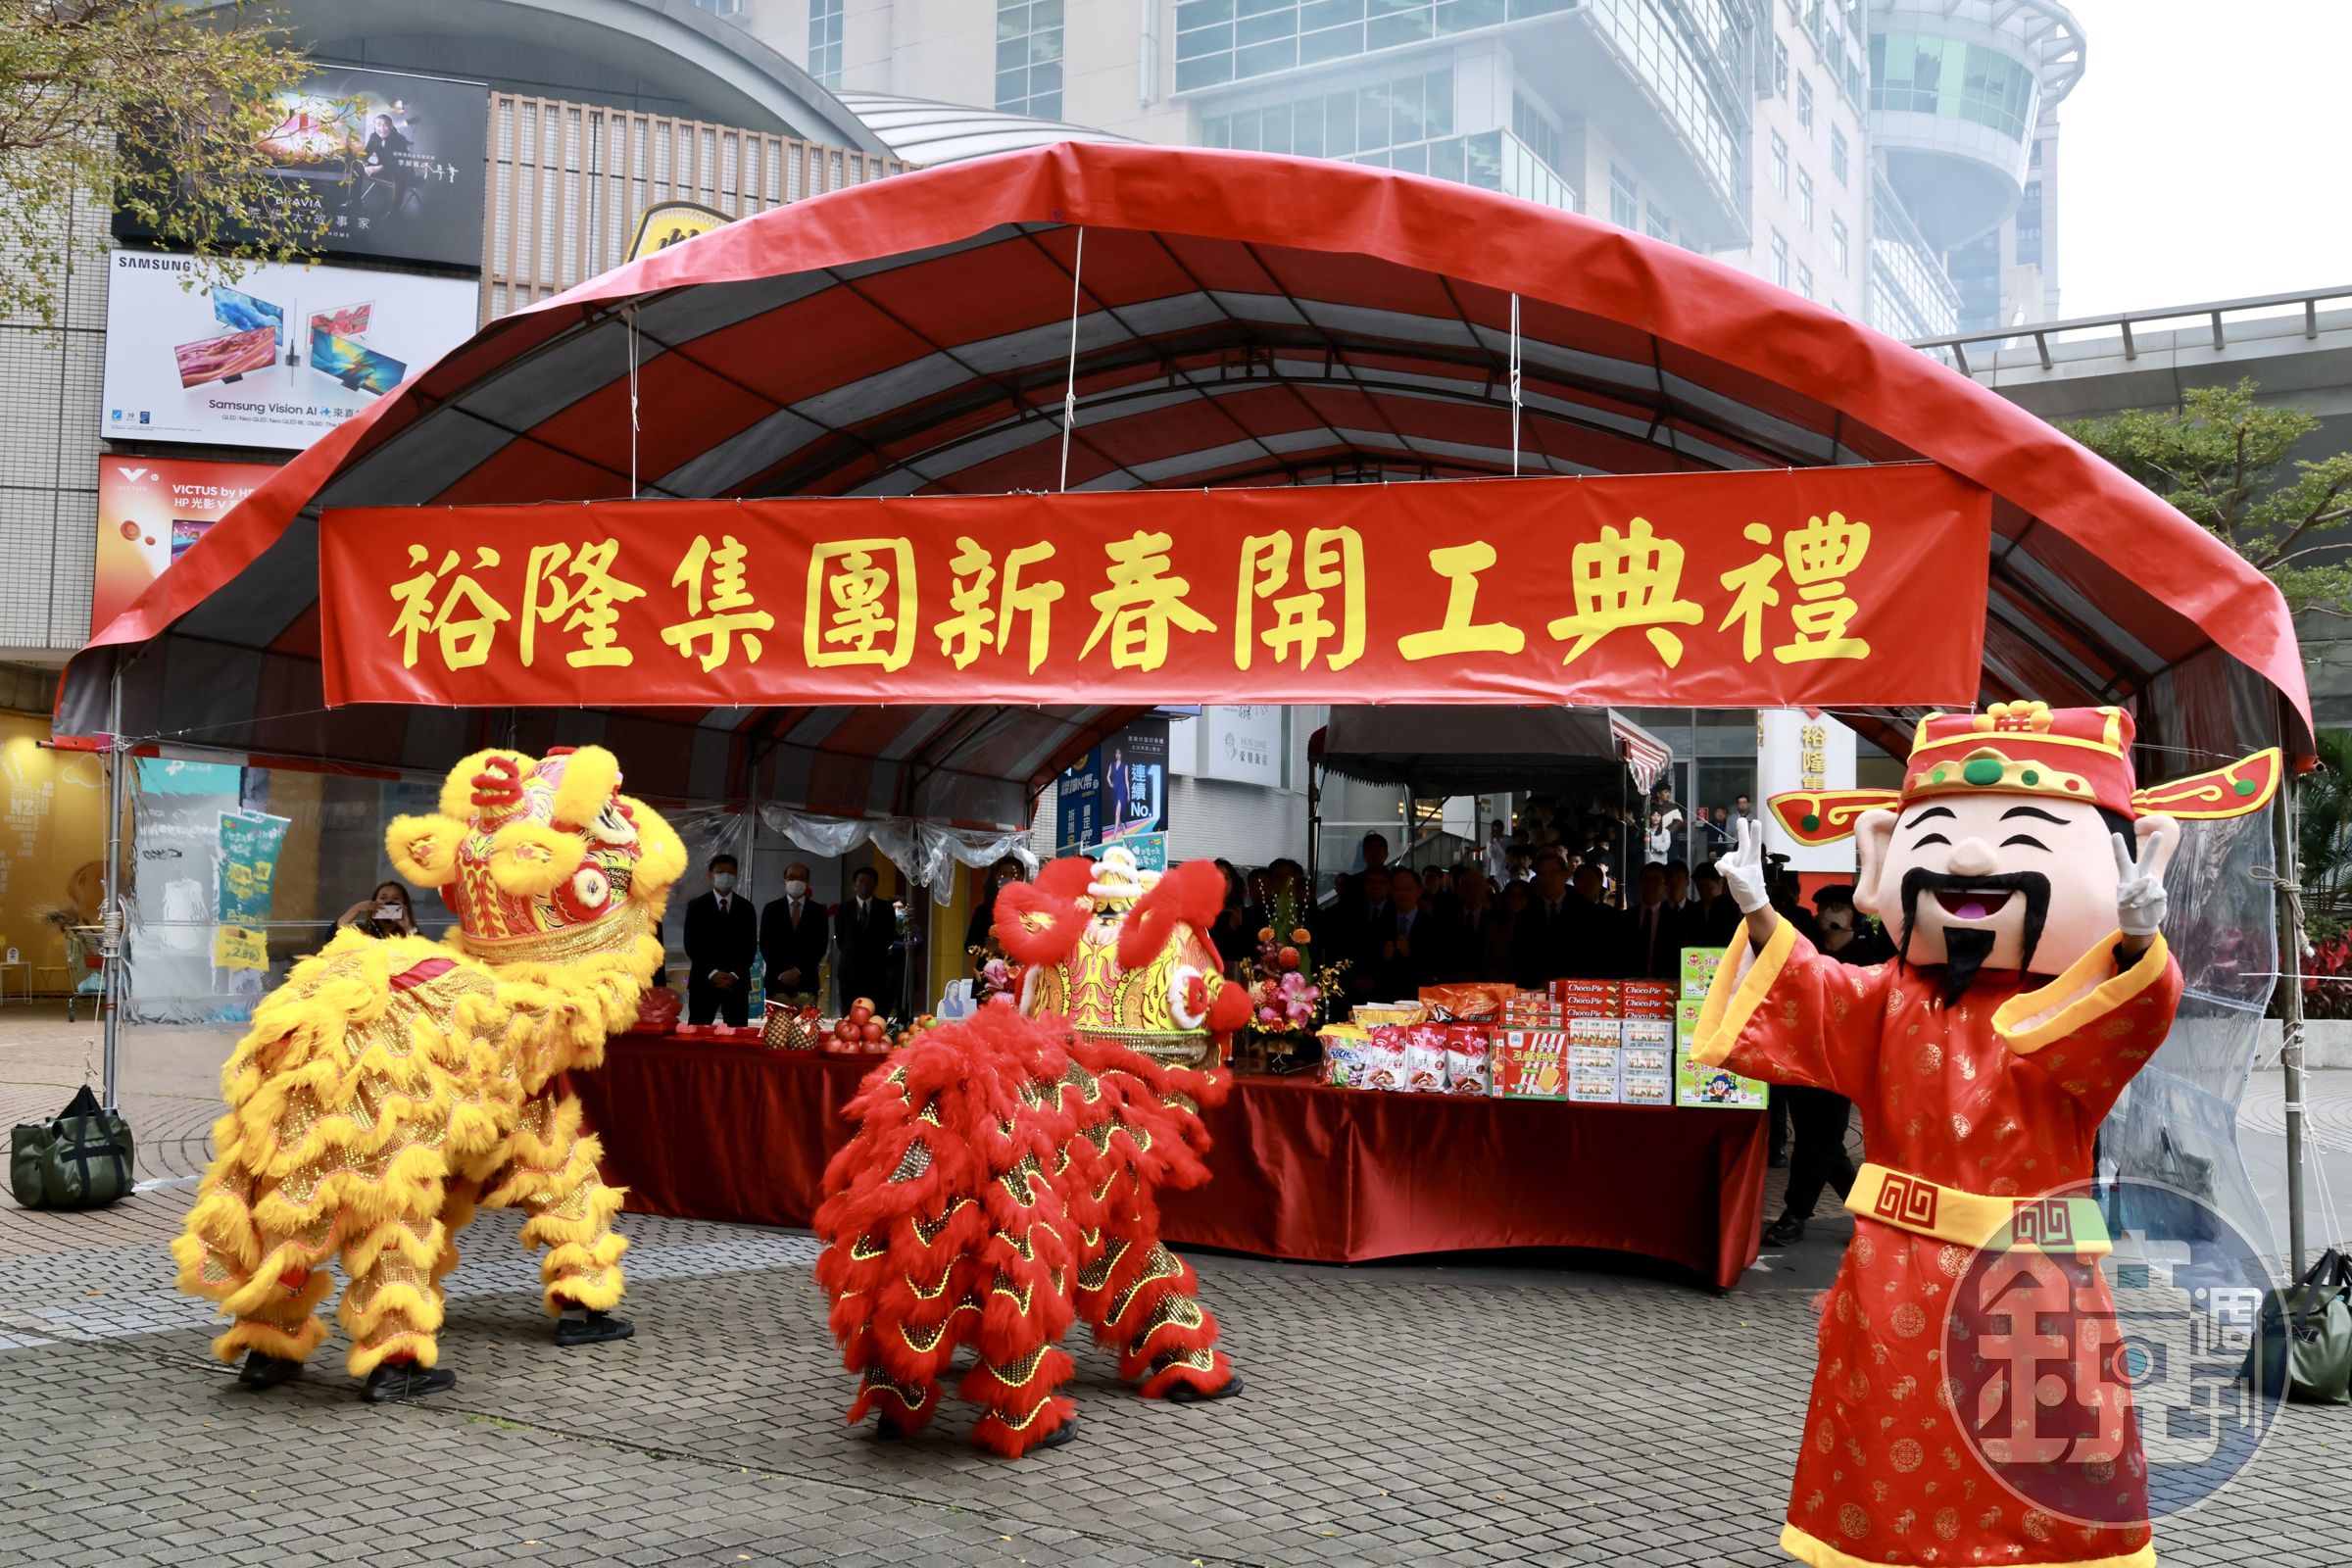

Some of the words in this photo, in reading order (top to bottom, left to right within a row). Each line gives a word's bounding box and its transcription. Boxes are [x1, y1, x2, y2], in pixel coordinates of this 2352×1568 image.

[119, 256, 191, 272] SAMSUNG
[209, 399, 266, 416] Samsung
[269, 402, 304, 416] Vision
[305, 405, 318, 416] AI
[332, 407, 361, 419] 來真
[172, 484, 218, 496] VICTUS
[220, 487, 236, 499] by
[174, 497, 190, 508] HP
[191, 497, 216, 510] 光影
[392, 514, 1869, 673] 裕隆集團新春開工典禮
[1131, 763, 1147, 801] 連續
[1131, 802, 1152, 817] No.
[1568, 983, 1591, 992] Choco
[1591, 984, 1603, 993] Pie
[1568, 996, 1590, 1004] Choco
[1590, 997, 1602, 1005] Pie
[1625, 999, 1648, 1007] Choco
[1567, 1008, 1590, 1017] Choco
[1589, 1009, 1602, 1018] Pie
